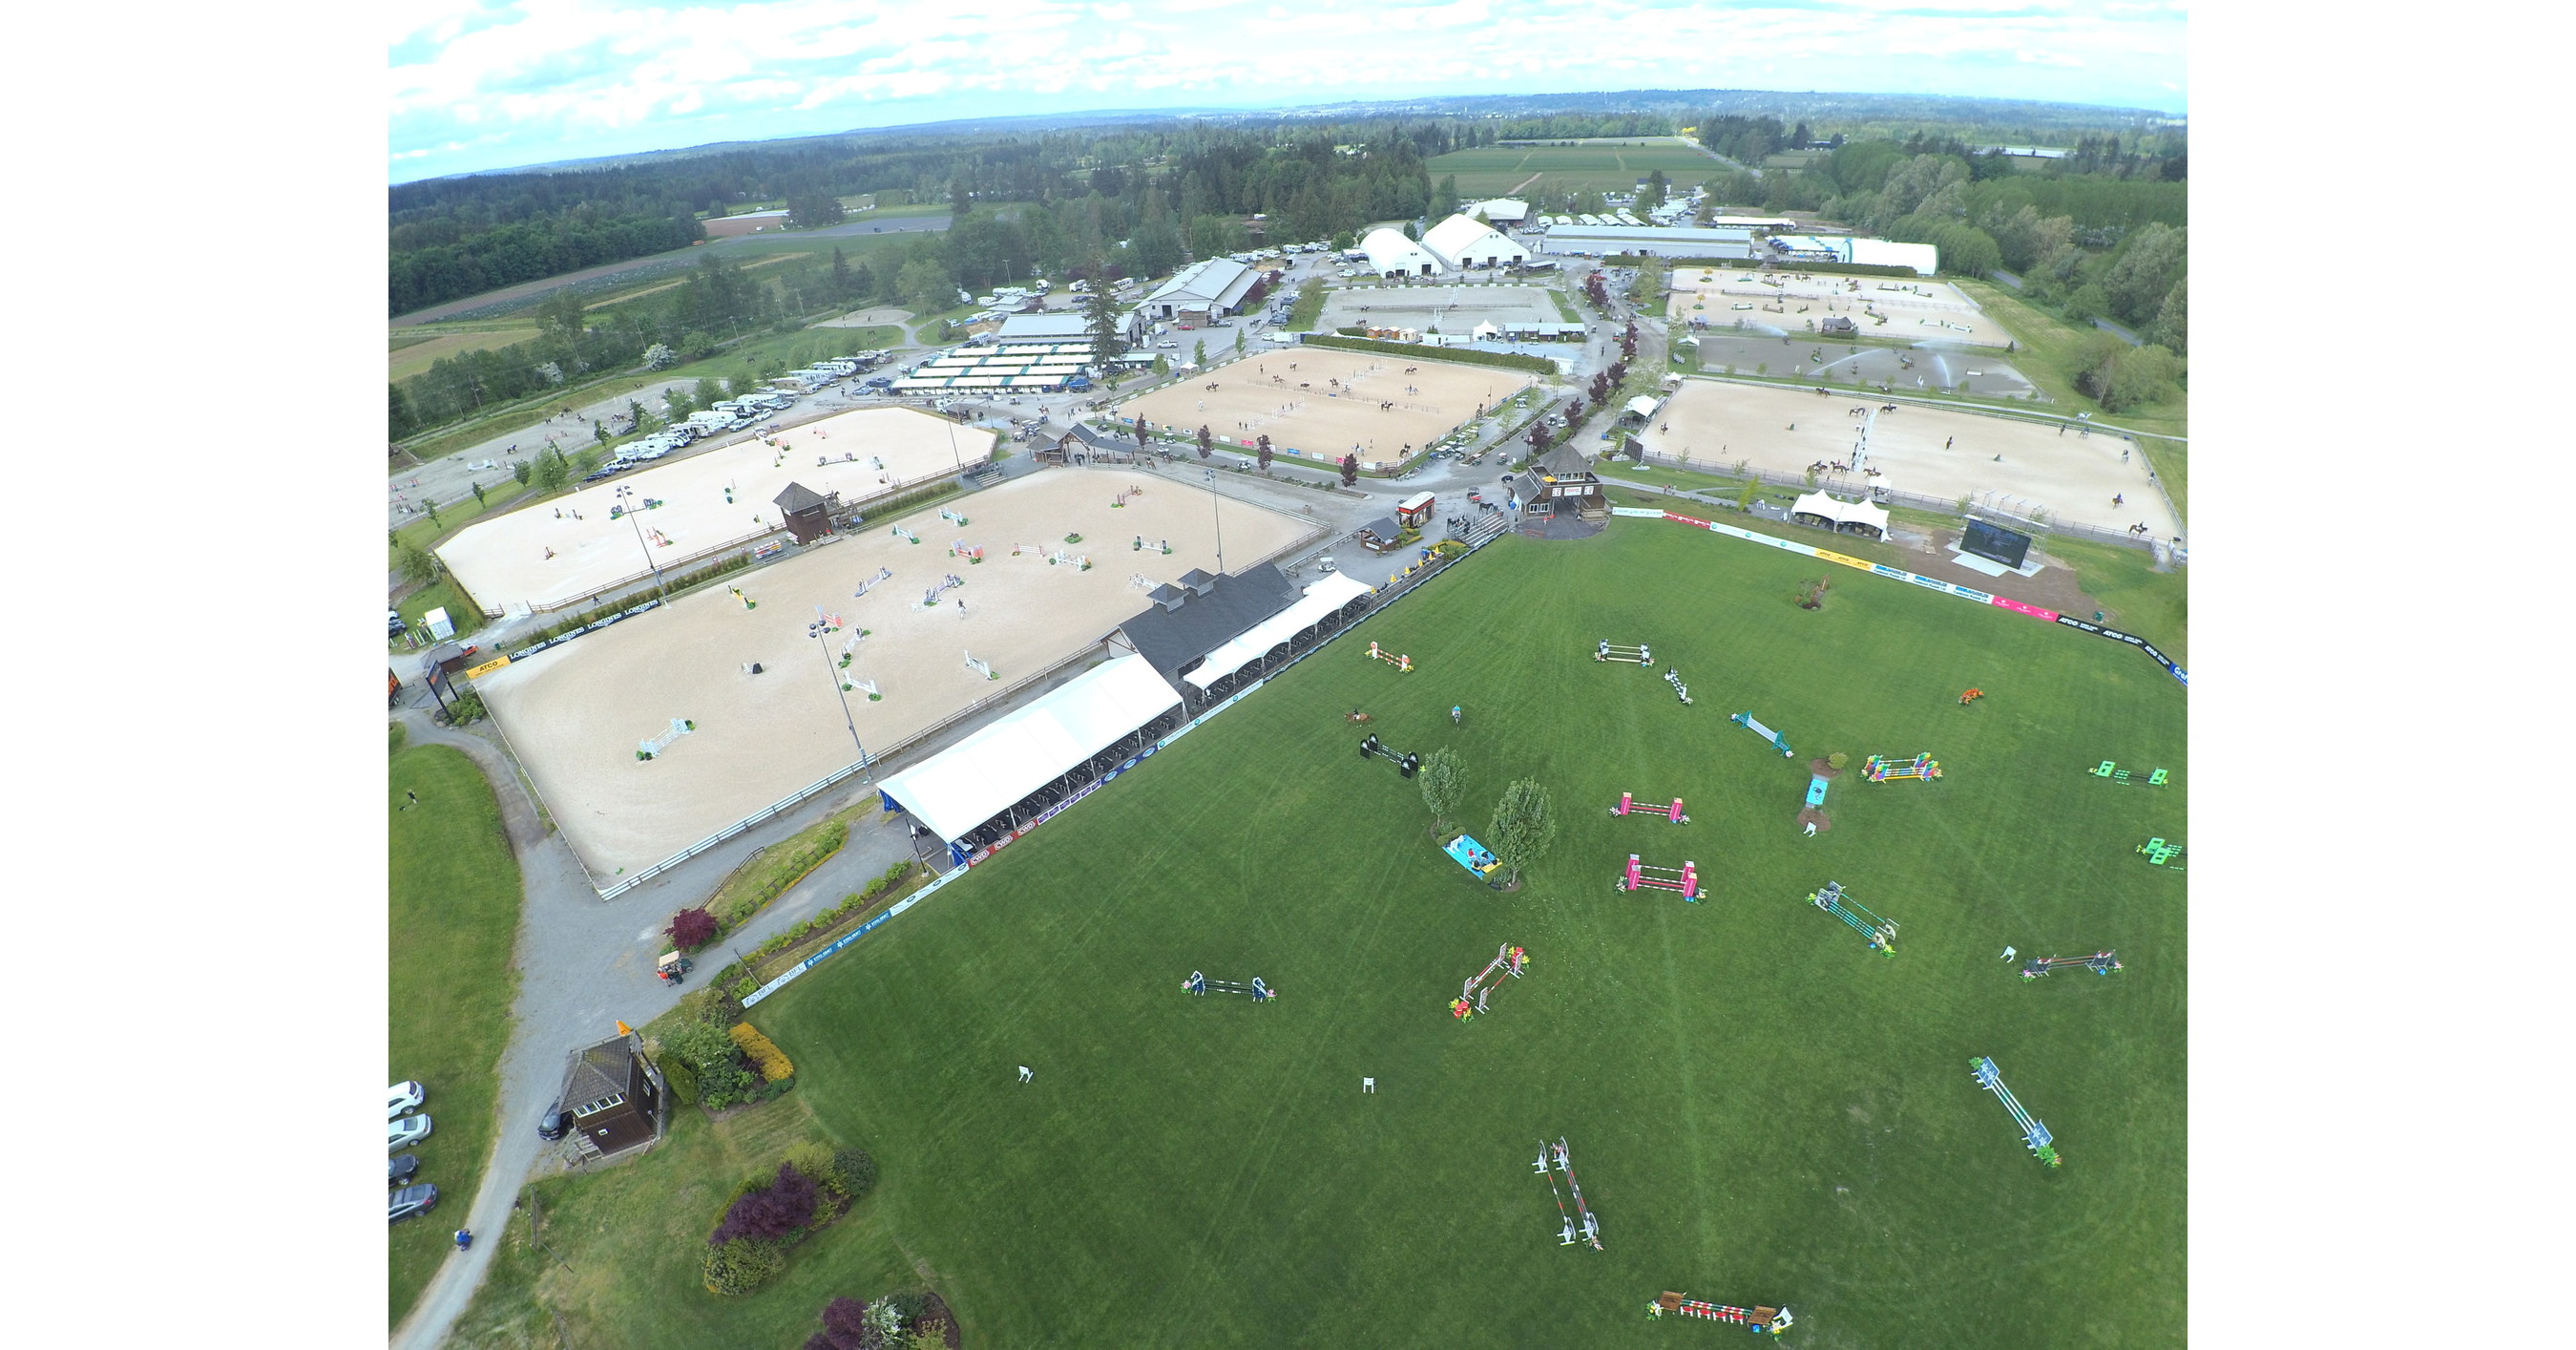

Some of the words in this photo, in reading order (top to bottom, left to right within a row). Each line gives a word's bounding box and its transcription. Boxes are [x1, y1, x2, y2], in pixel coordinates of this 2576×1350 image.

[624, 599, 659, 615] LONGINES
[587, 612, 622, 629] LONGINES
[2058, 617, 2078, 626] ATCO
[549, 626, 585, 644] LONGINES
[2103, 630, 2123, 639] ATCO
[510, 642, 547, 659] LONGINES
[2144, 644, 2158, 657] ATCO
[479, 661, 498, 672] ATCO
